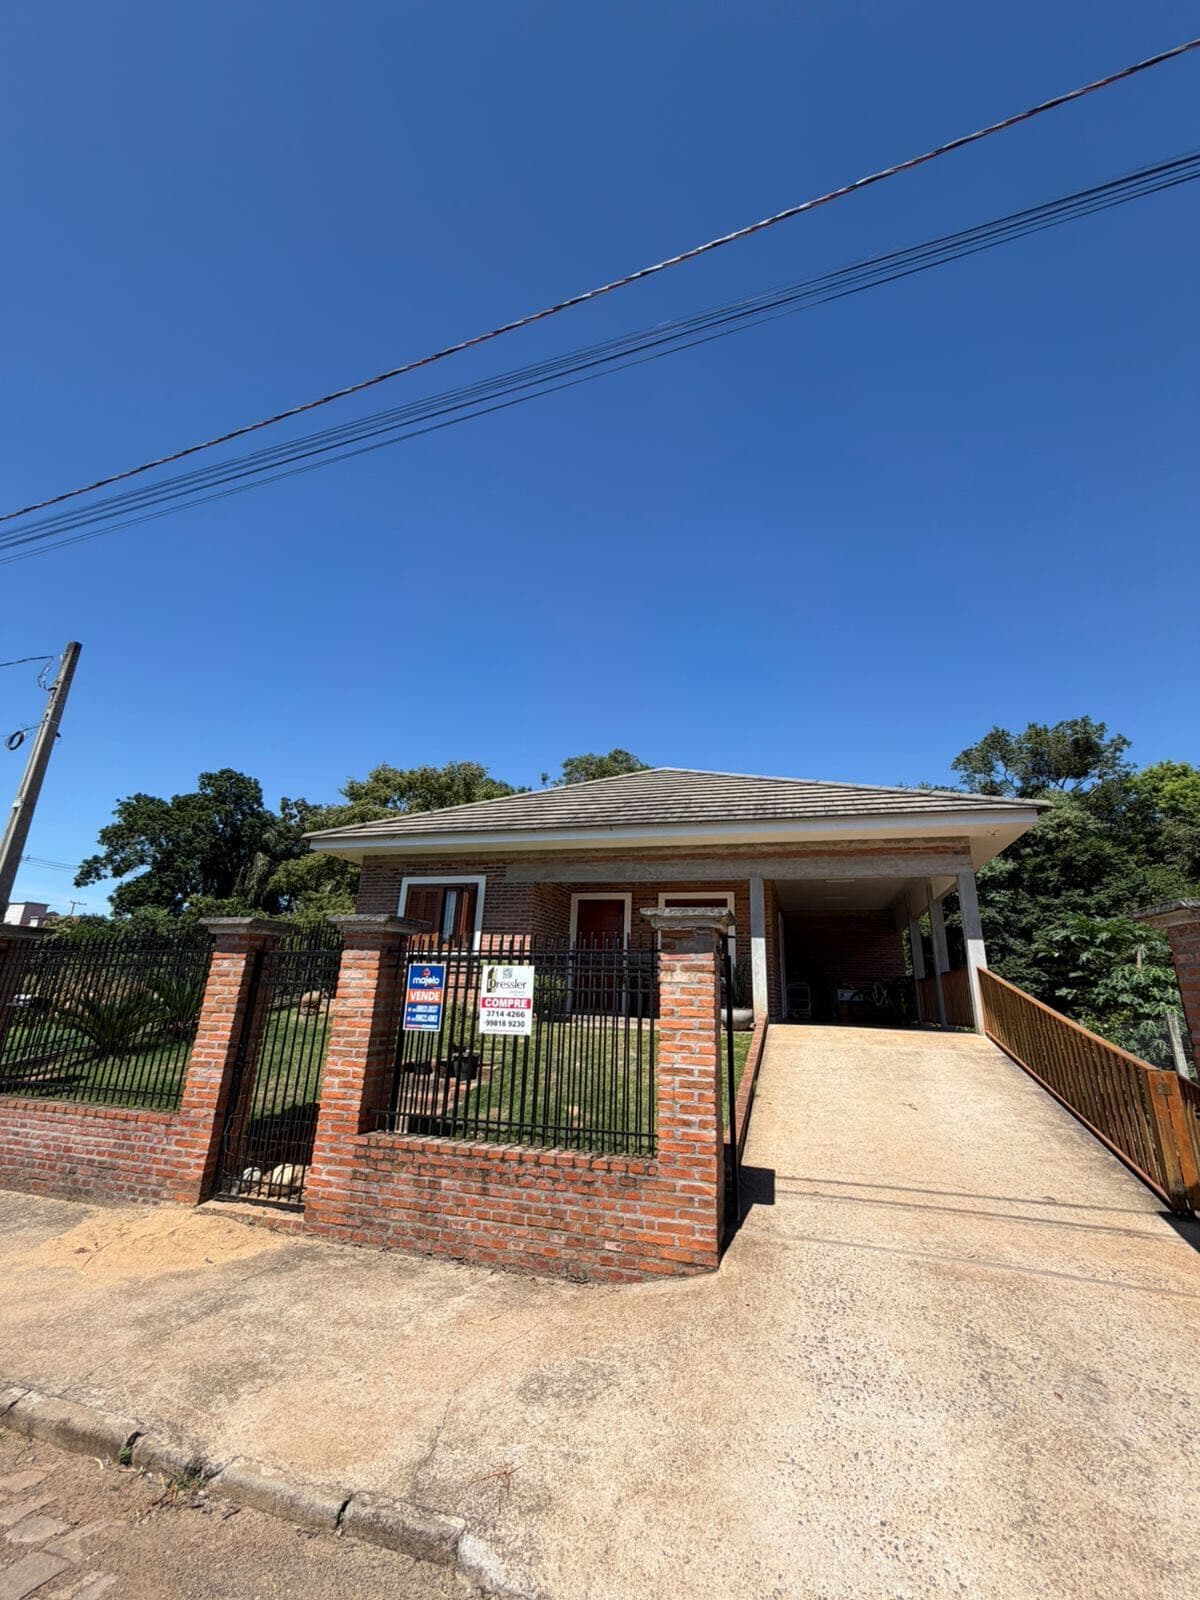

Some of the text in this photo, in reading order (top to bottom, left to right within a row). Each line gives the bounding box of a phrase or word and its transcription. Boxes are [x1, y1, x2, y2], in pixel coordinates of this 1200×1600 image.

[487, 979, 527, 989] Dressler
[410, 991, 441, 1001] VENDE
[484, 998, 529, 1008] COMPRE
[508, 1020, 526, 1028] 9230
